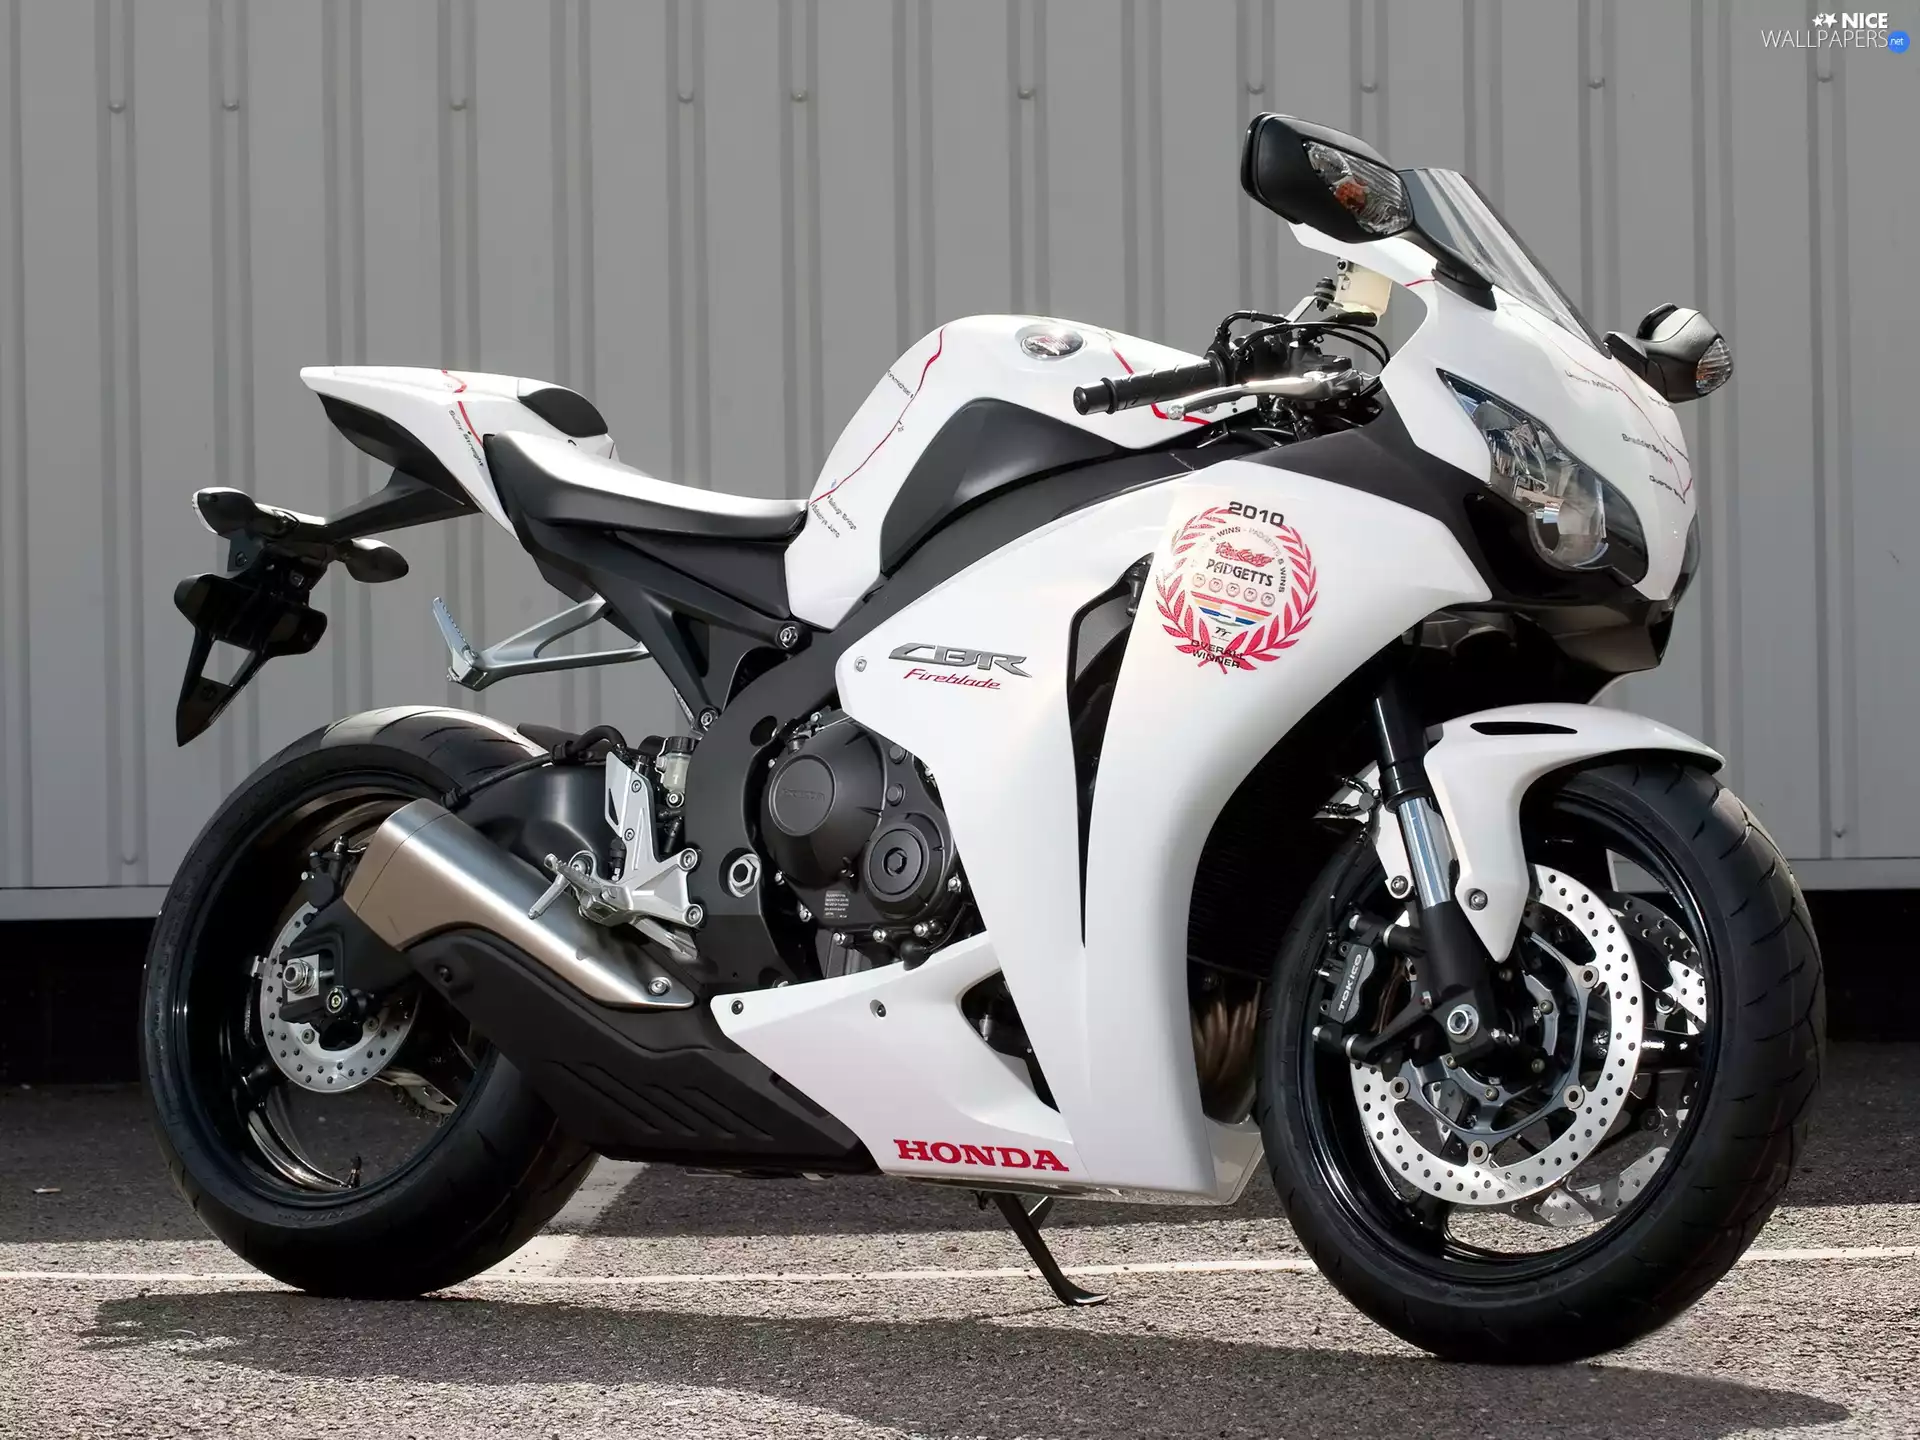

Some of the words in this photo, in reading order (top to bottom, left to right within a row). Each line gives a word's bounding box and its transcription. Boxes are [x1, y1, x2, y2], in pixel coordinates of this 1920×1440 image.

[1228, 501, 1285, 527] 2010
[1206, 558, 1274, 587] PADGETTS
[1217, 526, 1242, 538] WINS
[1279, 566, 1287, 593] WINS
[889, 642, 1032, 678] CBR
[1190, 639, 1246, 662] OVERALL
[1192, 649, 1241, 669] WINNER
[903, 668, 1001, 690] Fireblade
[1338, 953, 1362, 1012] TOKICO
[893, 1138, 1070, 1172] HONDA
